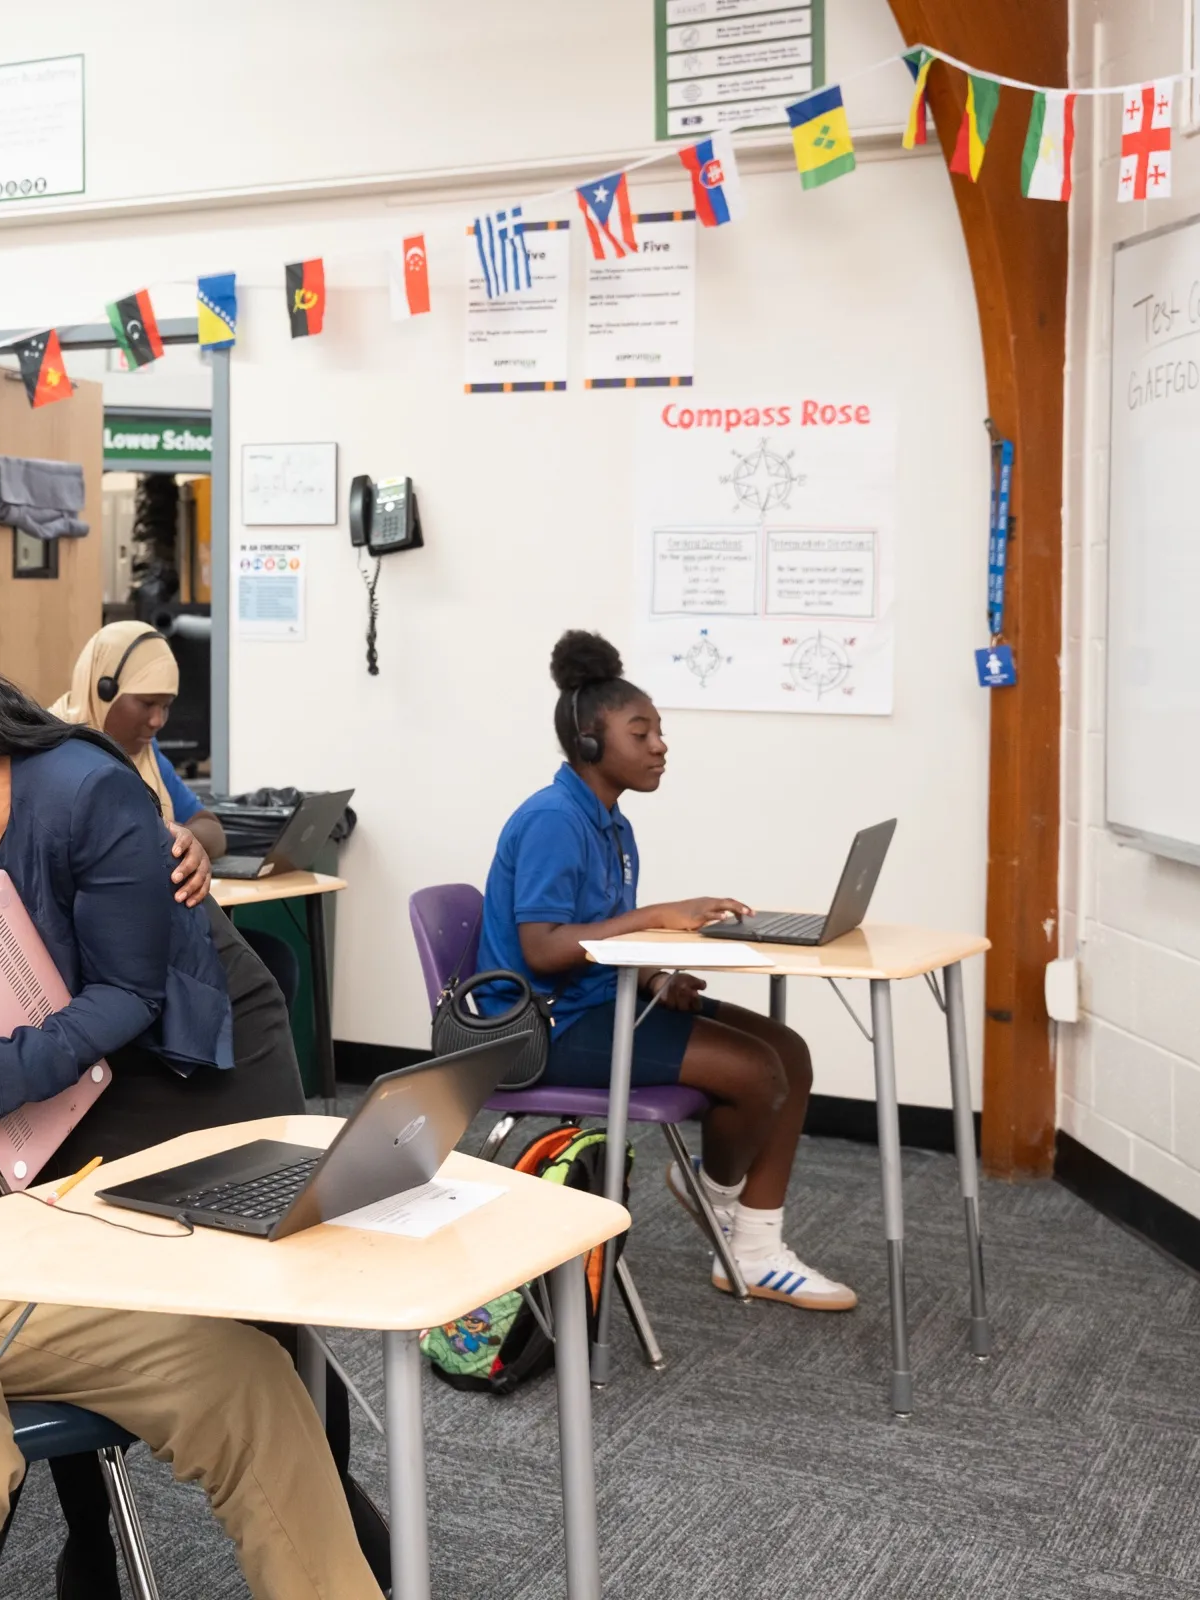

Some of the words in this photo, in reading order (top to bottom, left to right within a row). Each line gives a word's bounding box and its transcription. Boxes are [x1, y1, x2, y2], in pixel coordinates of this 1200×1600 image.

[642, 242, 671, 253] Five
[1132, 291, 1180, 344] Test
[661, 403, 792, 433] Compass
[800, 400, 871, 428] Rose
[103, 428, 160, 449] Lower
[260, 544, 300, 552] EMERGENCY
